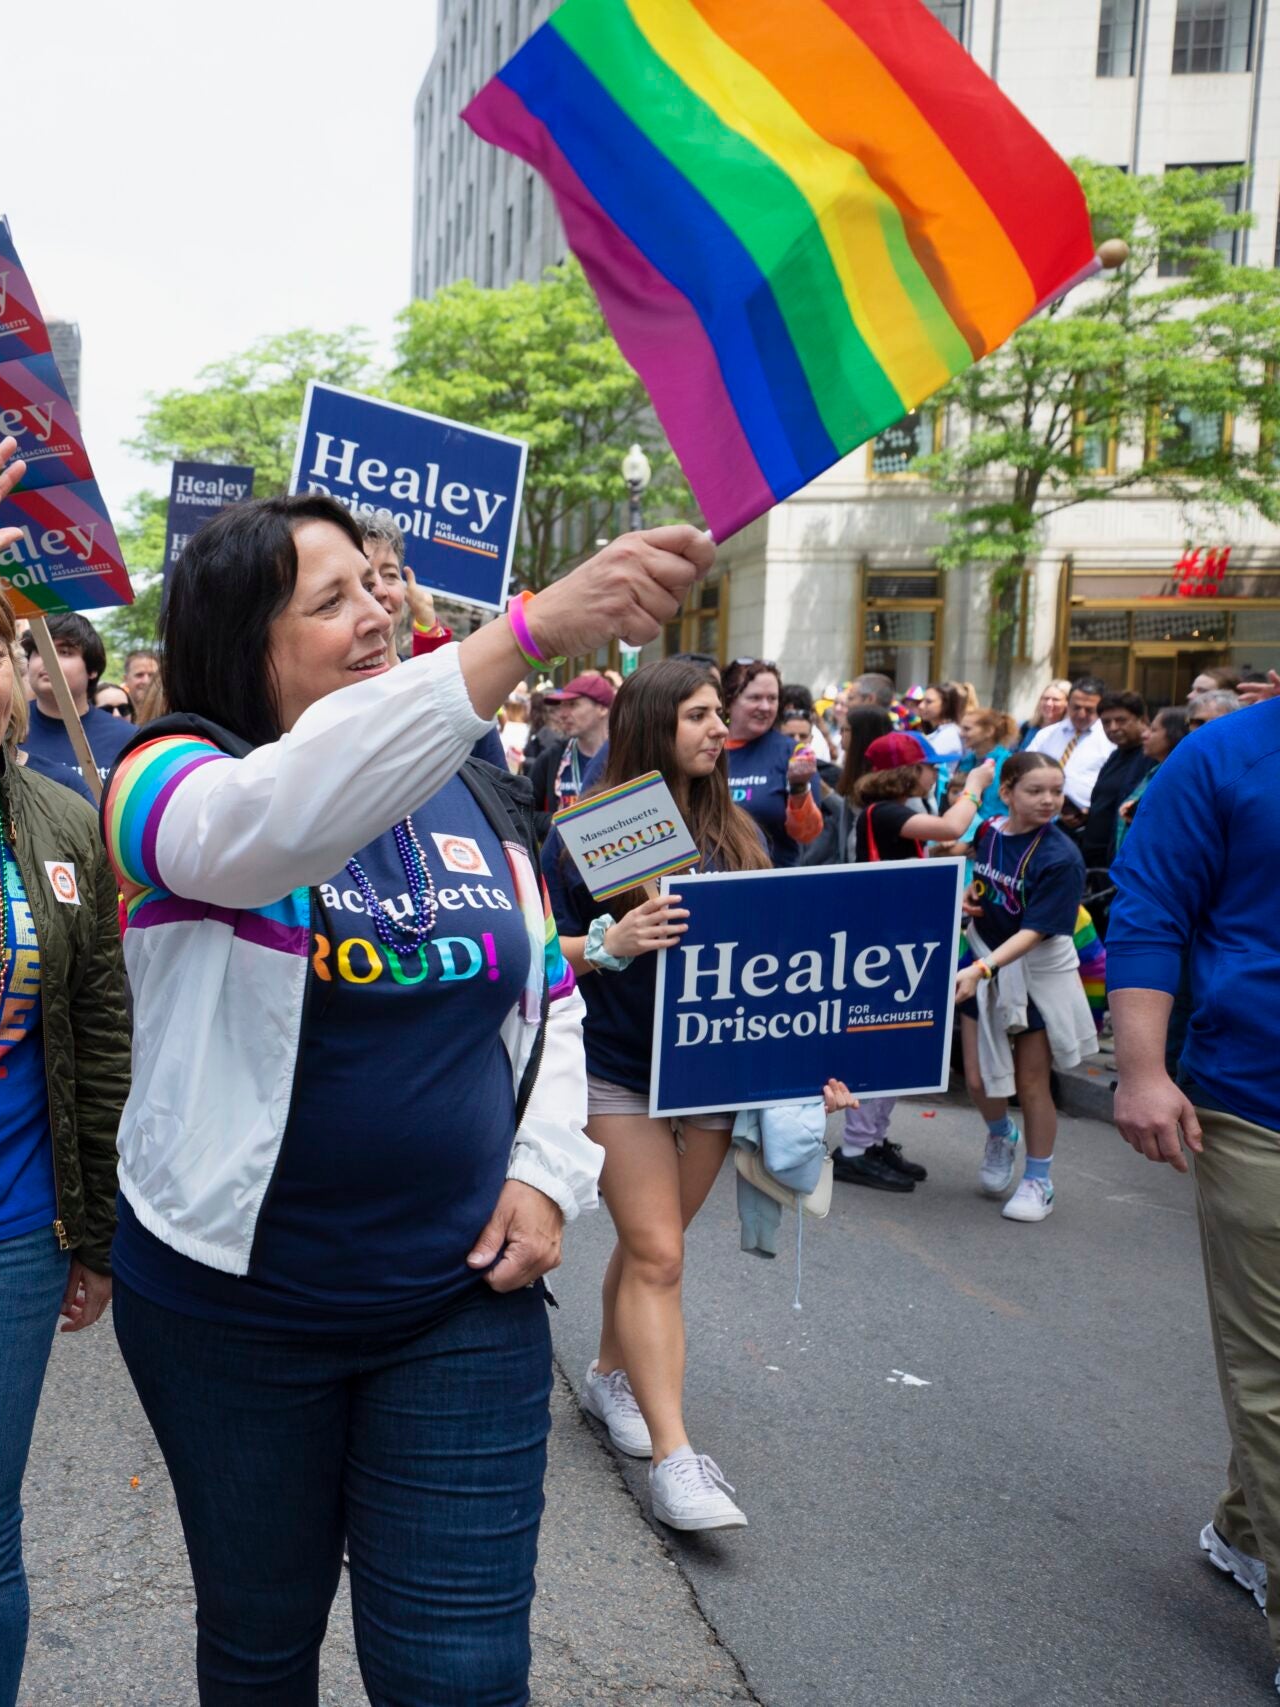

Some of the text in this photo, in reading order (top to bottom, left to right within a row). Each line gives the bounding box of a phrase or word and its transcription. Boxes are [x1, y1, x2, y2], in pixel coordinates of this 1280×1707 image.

[176, 475, 248, 501] Healey
[309, 431, 507, 534] Healey
[175, 493, 223, 507] Driscoll
[434, 529, 499, 553] MASSACHUSETTS
[435, 521, 452, 532] FOR
[50, 563, 111, 577] MASSACHUSETTS
[579, 806, 659, 845] Massachusetts
[581, 819, 676, 869] PROUD
[312, 932, 500, 985] ROUD!
[677, 930, 941, 1003] Healey
[674, 998, 870, 1048] Driscoll FOR
[848, 1010, 934, 1025] MASSACHUSETTS
